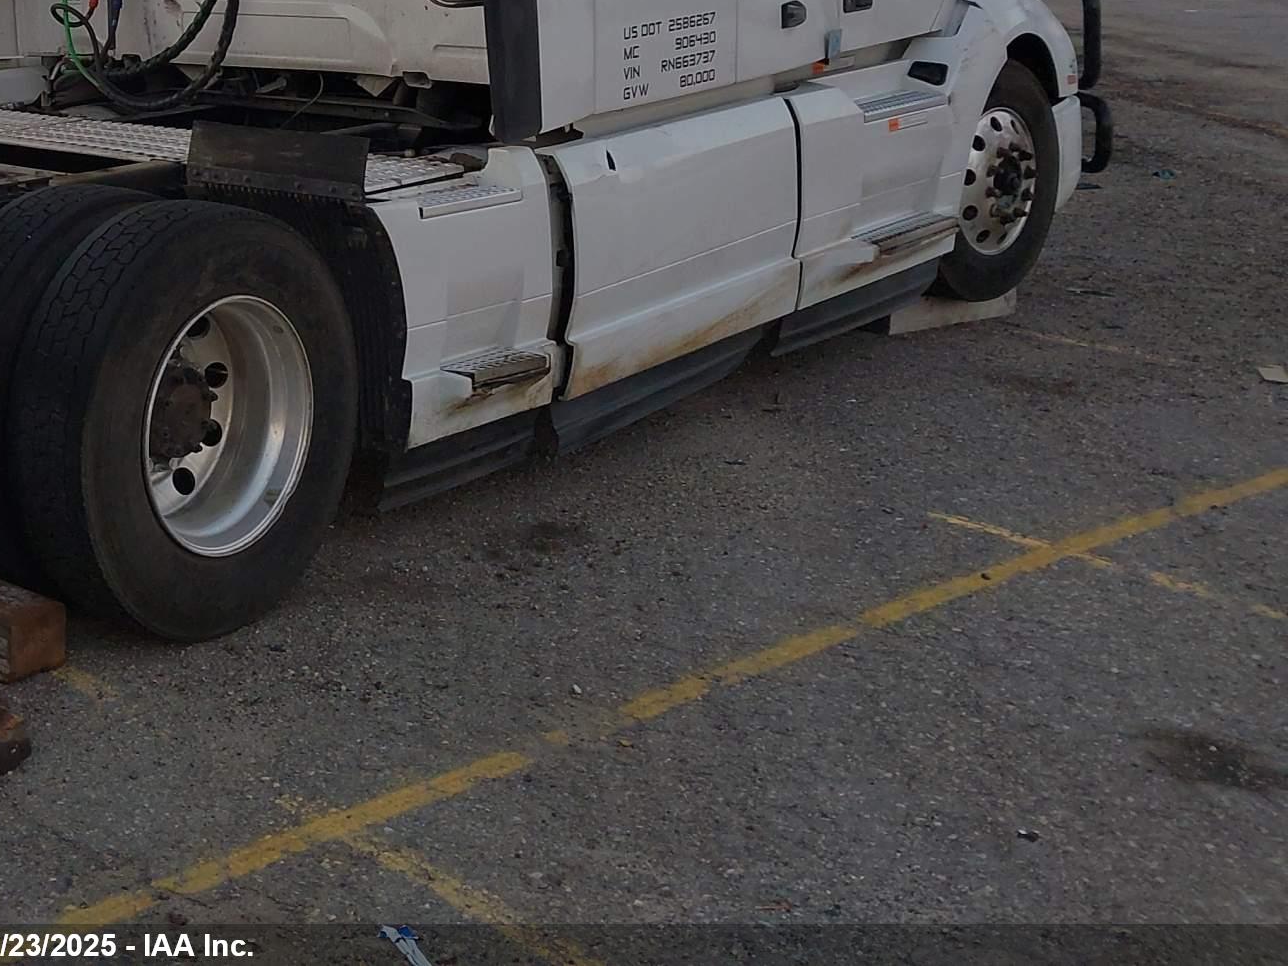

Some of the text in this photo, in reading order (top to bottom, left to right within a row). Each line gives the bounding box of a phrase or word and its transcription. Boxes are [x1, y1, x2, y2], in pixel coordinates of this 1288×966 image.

[623, 25, 639, 40] US
[641, 21, 663, 38] DOT
[623, 45, 640, 61] MC
[623, 65, 641, 80] VIN
[623, 68, 716, 100] GVW 80,000
